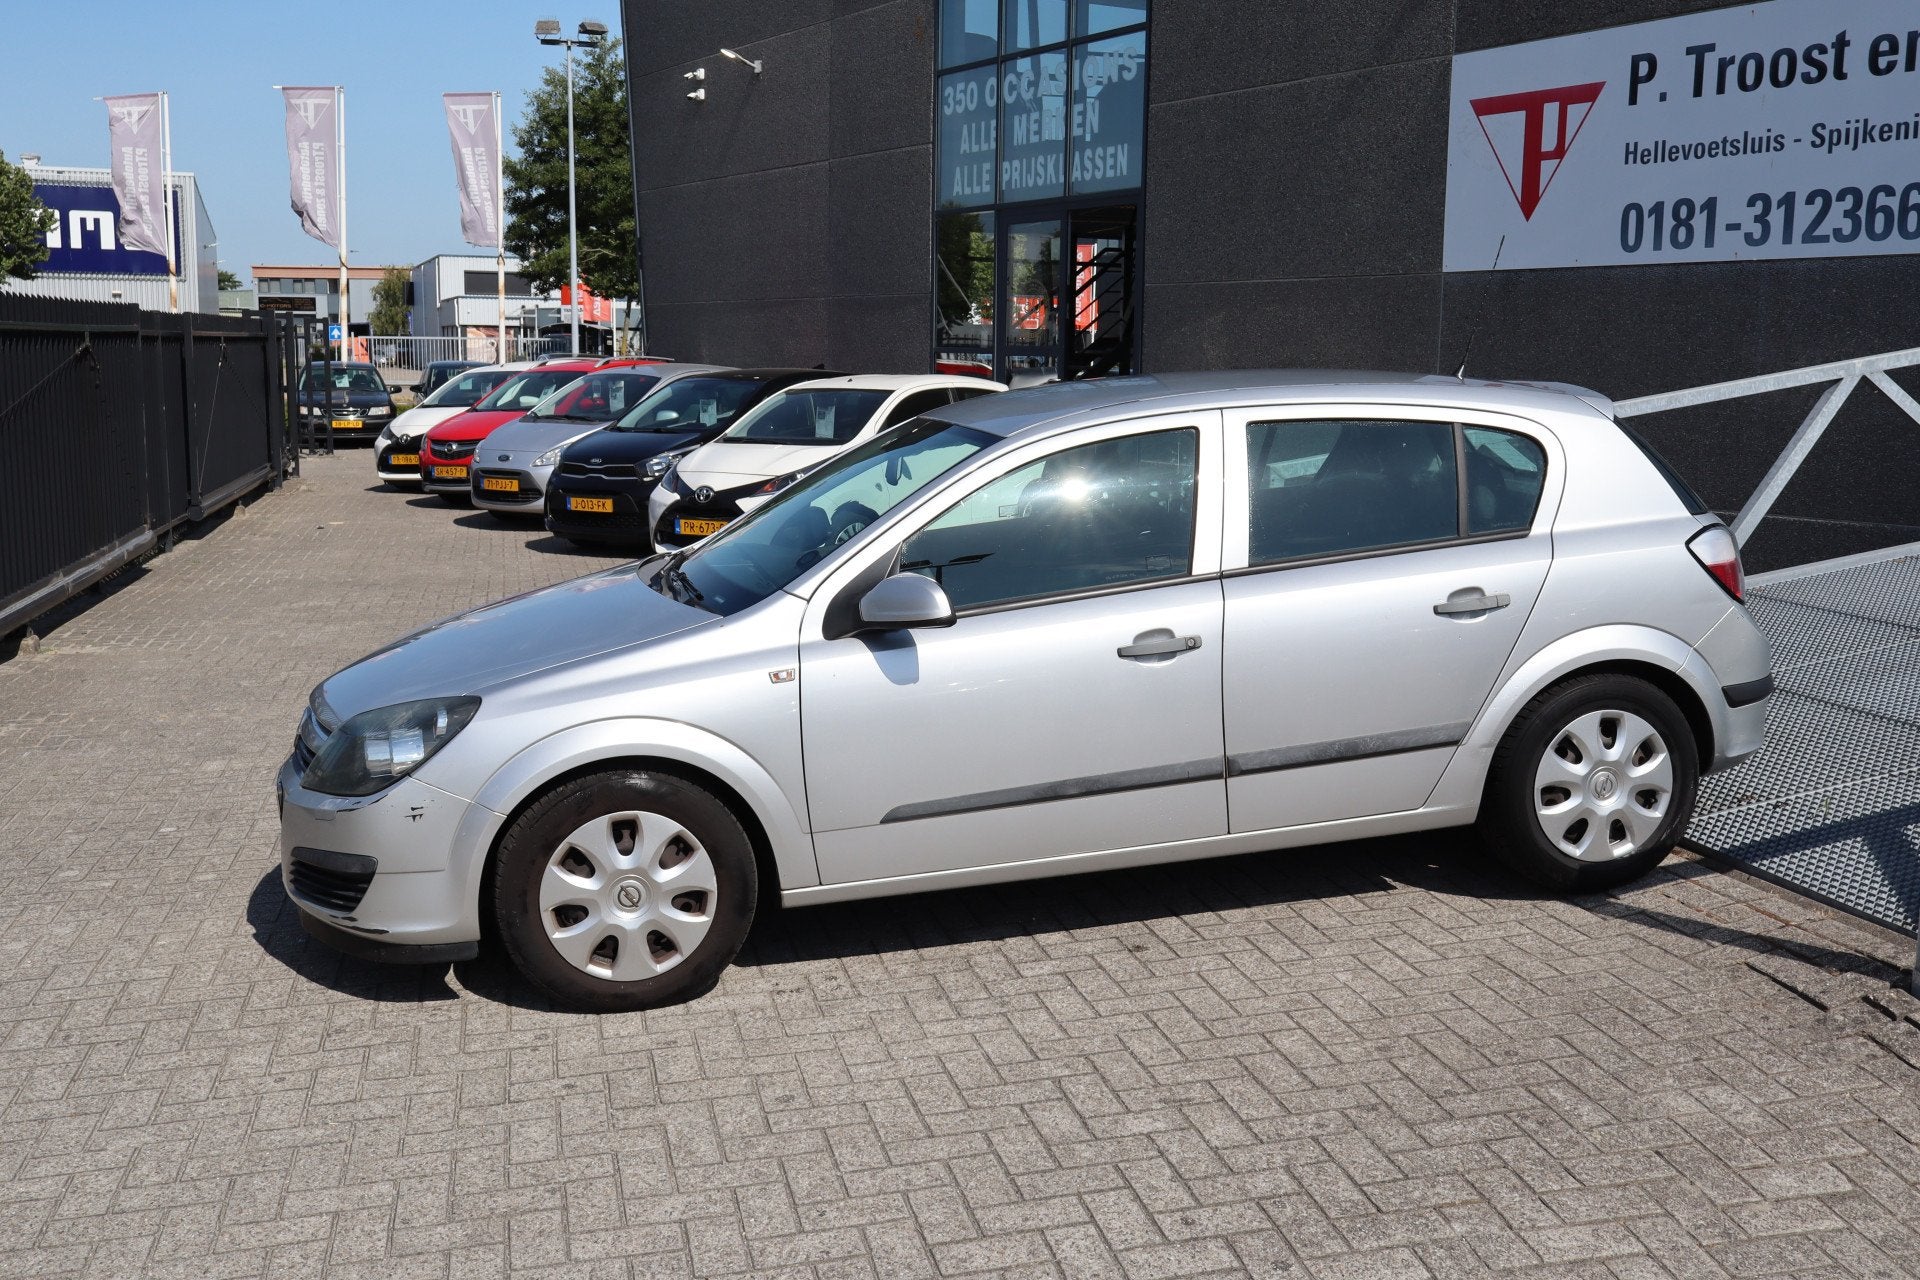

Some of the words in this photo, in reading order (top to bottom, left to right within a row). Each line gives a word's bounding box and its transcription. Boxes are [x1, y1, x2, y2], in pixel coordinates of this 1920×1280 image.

[943, 80, 978, 116] 350
[985, 47, 1138, 108] OCCASIONS
[1628, 52, 1668, 106] P.
[1685, 29, 1851, 99] Troost
[960, 118, 997, 155] ALLE
[1013, 98, 1100, 147] MERKEN
[1624, 128, 1786, 166] Hellevoetsluis
[952, 162, 991, 196] ALLE
[1002, 143, 1128, 191] PRIJSKLASSEN
[486, 479, 514, 490] 71-PJJ-7
[573, 497, 609, 512] J-013-FK
